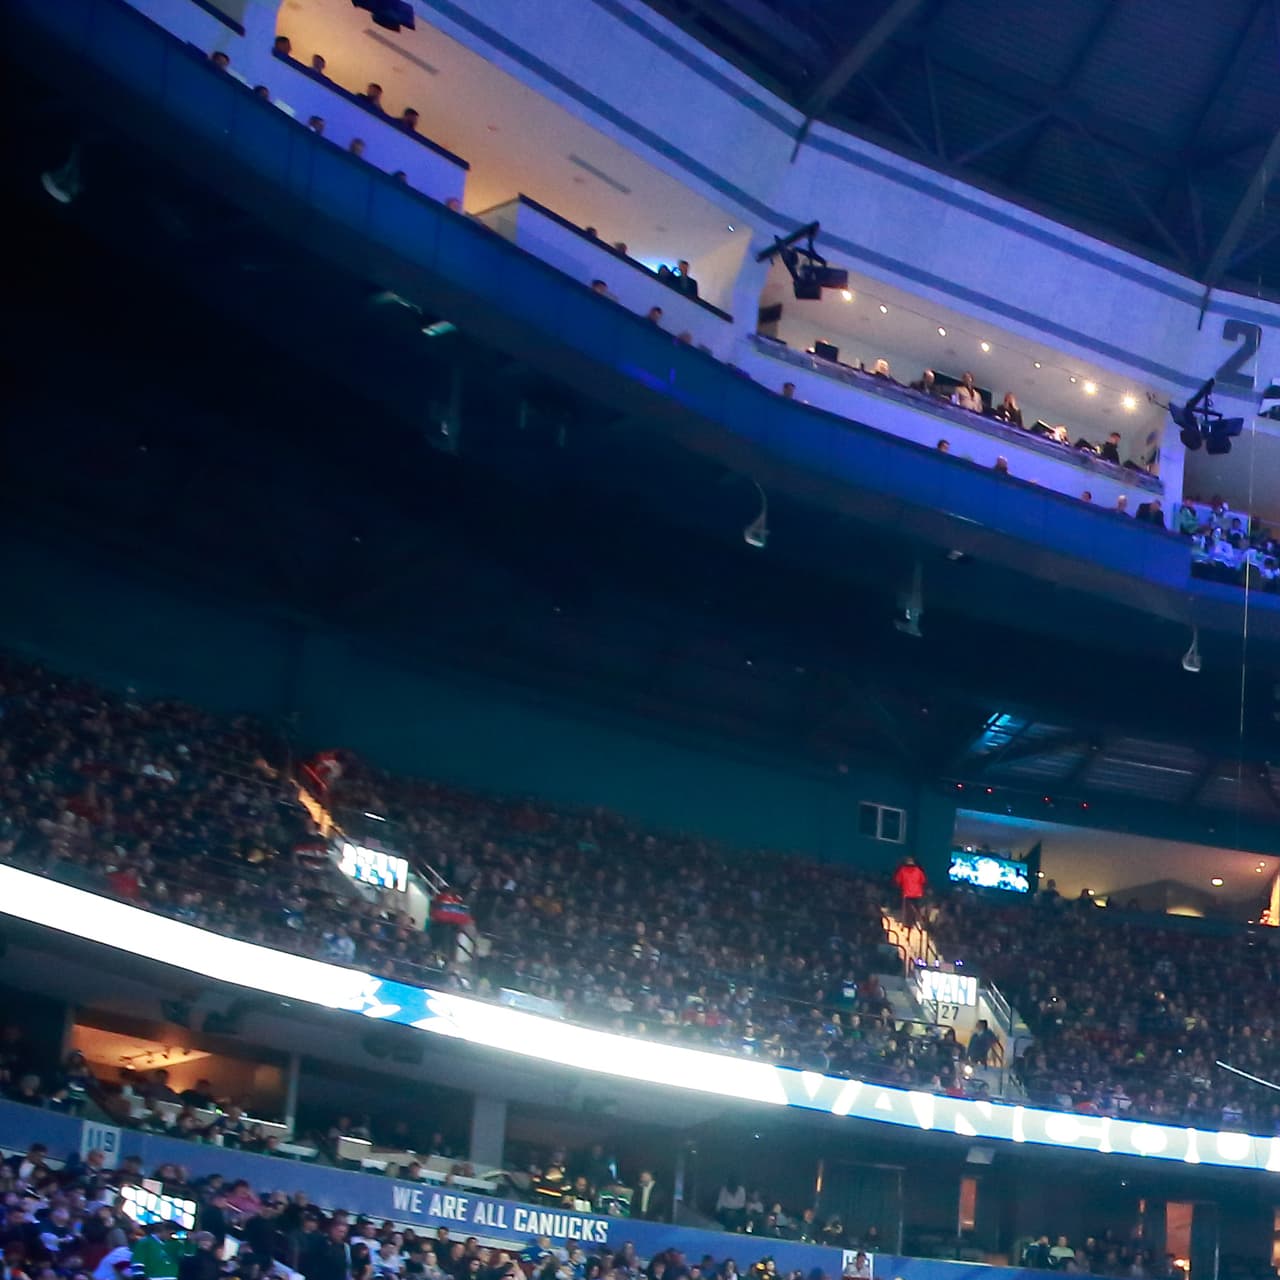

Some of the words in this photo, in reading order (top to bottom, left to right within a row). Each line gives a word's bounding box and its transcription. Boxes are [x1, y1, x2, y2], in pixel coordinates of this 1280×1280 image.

[1217, 319, 1262, 389] 2
[392, 1186, 424, 1216] WE
[429, 1195, 468, 1227] ARE
[474, 1203, 508, 1230] ALL
[514, 1209, 609, 1244] CANUCKS
